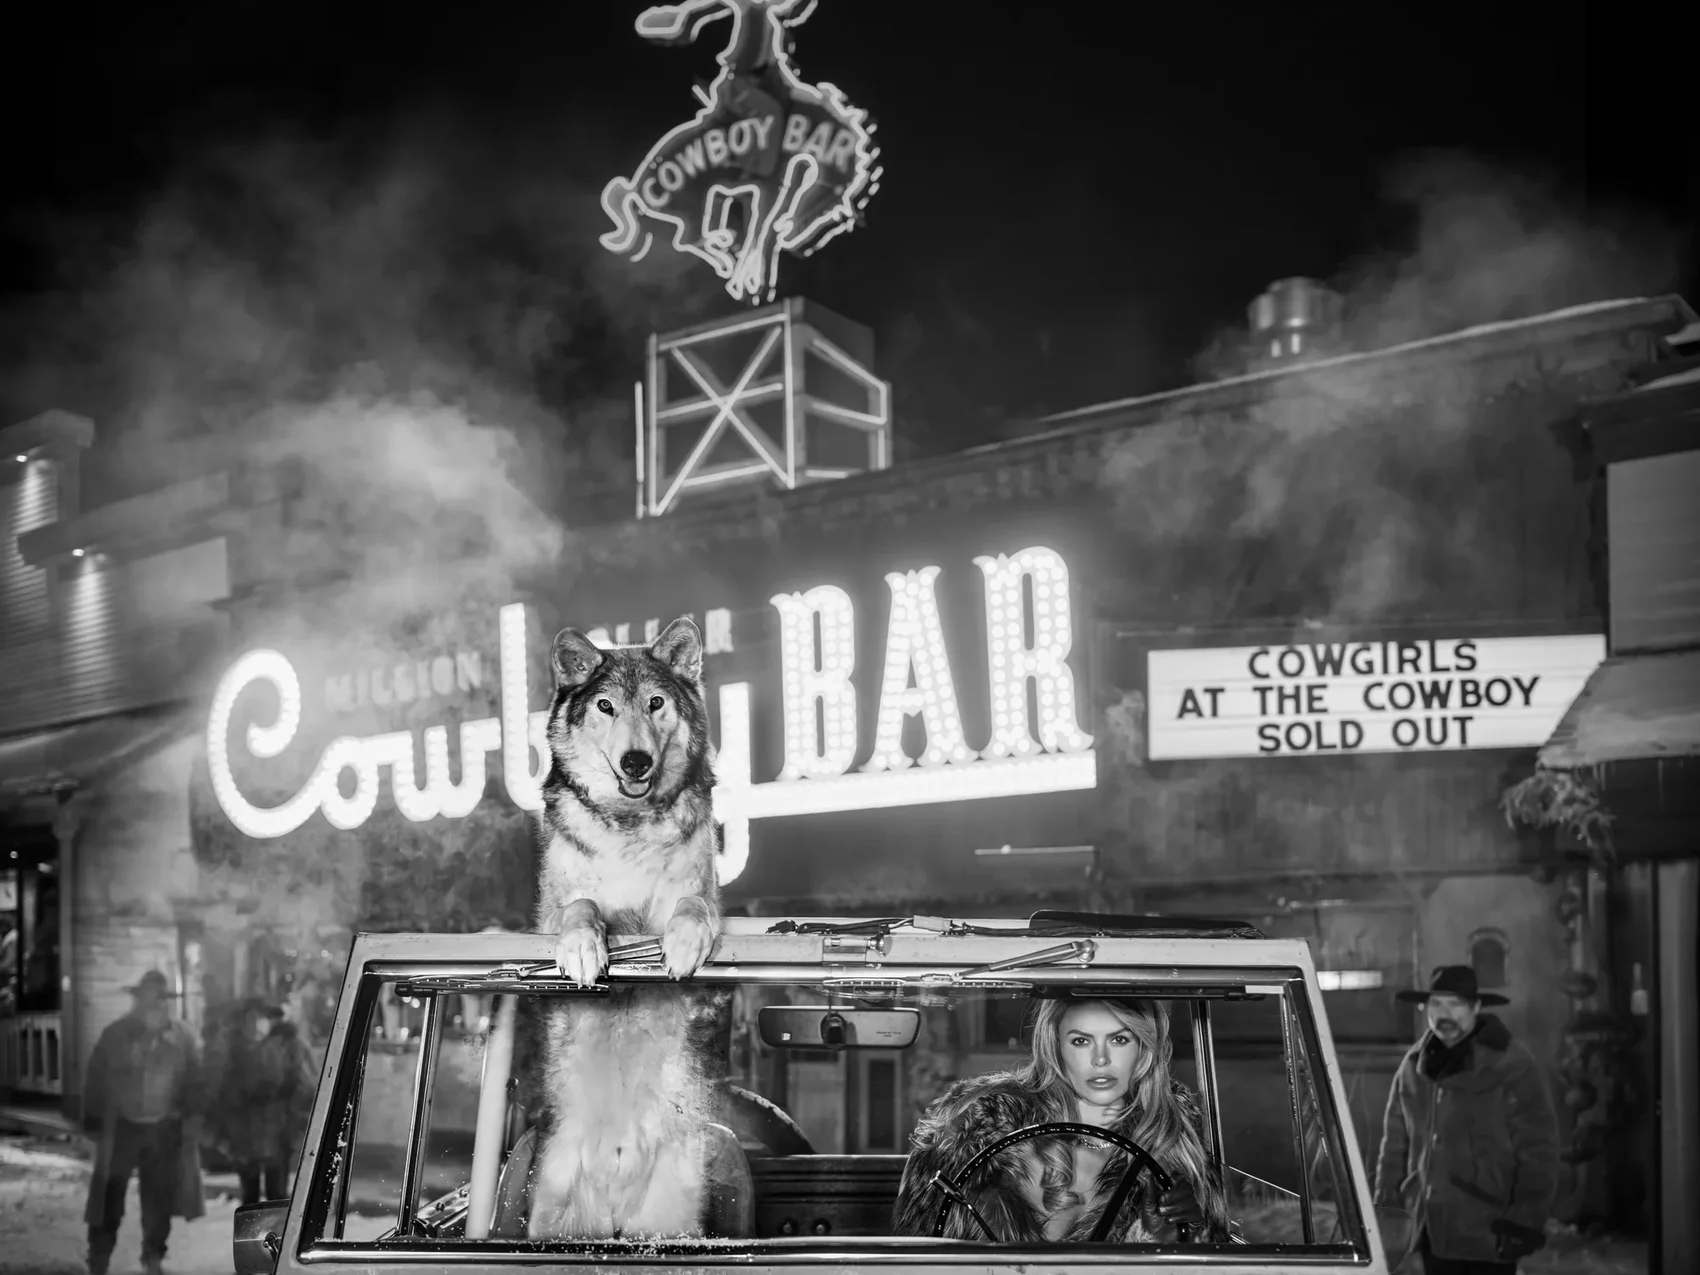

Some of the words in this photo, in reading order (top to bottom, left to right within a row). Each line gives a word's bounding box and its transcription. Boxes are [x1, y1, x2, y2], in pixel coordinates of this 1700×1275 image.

[642, 114, 775, 207] COWBOY
[782, 113, 858, 174] BAR
[769, 545, 1095, 782] BAR
[1248, 640, 1477, 678] COWGIRLS
[1176, 687, 1226, 719] AT
[1253, 684, 1328, 716] THE
[1363, 676, 1541, 711] COWBOY
[1258, 719, 1364, 753] SOLD
[1392, 716, 1474, 747] OUT
